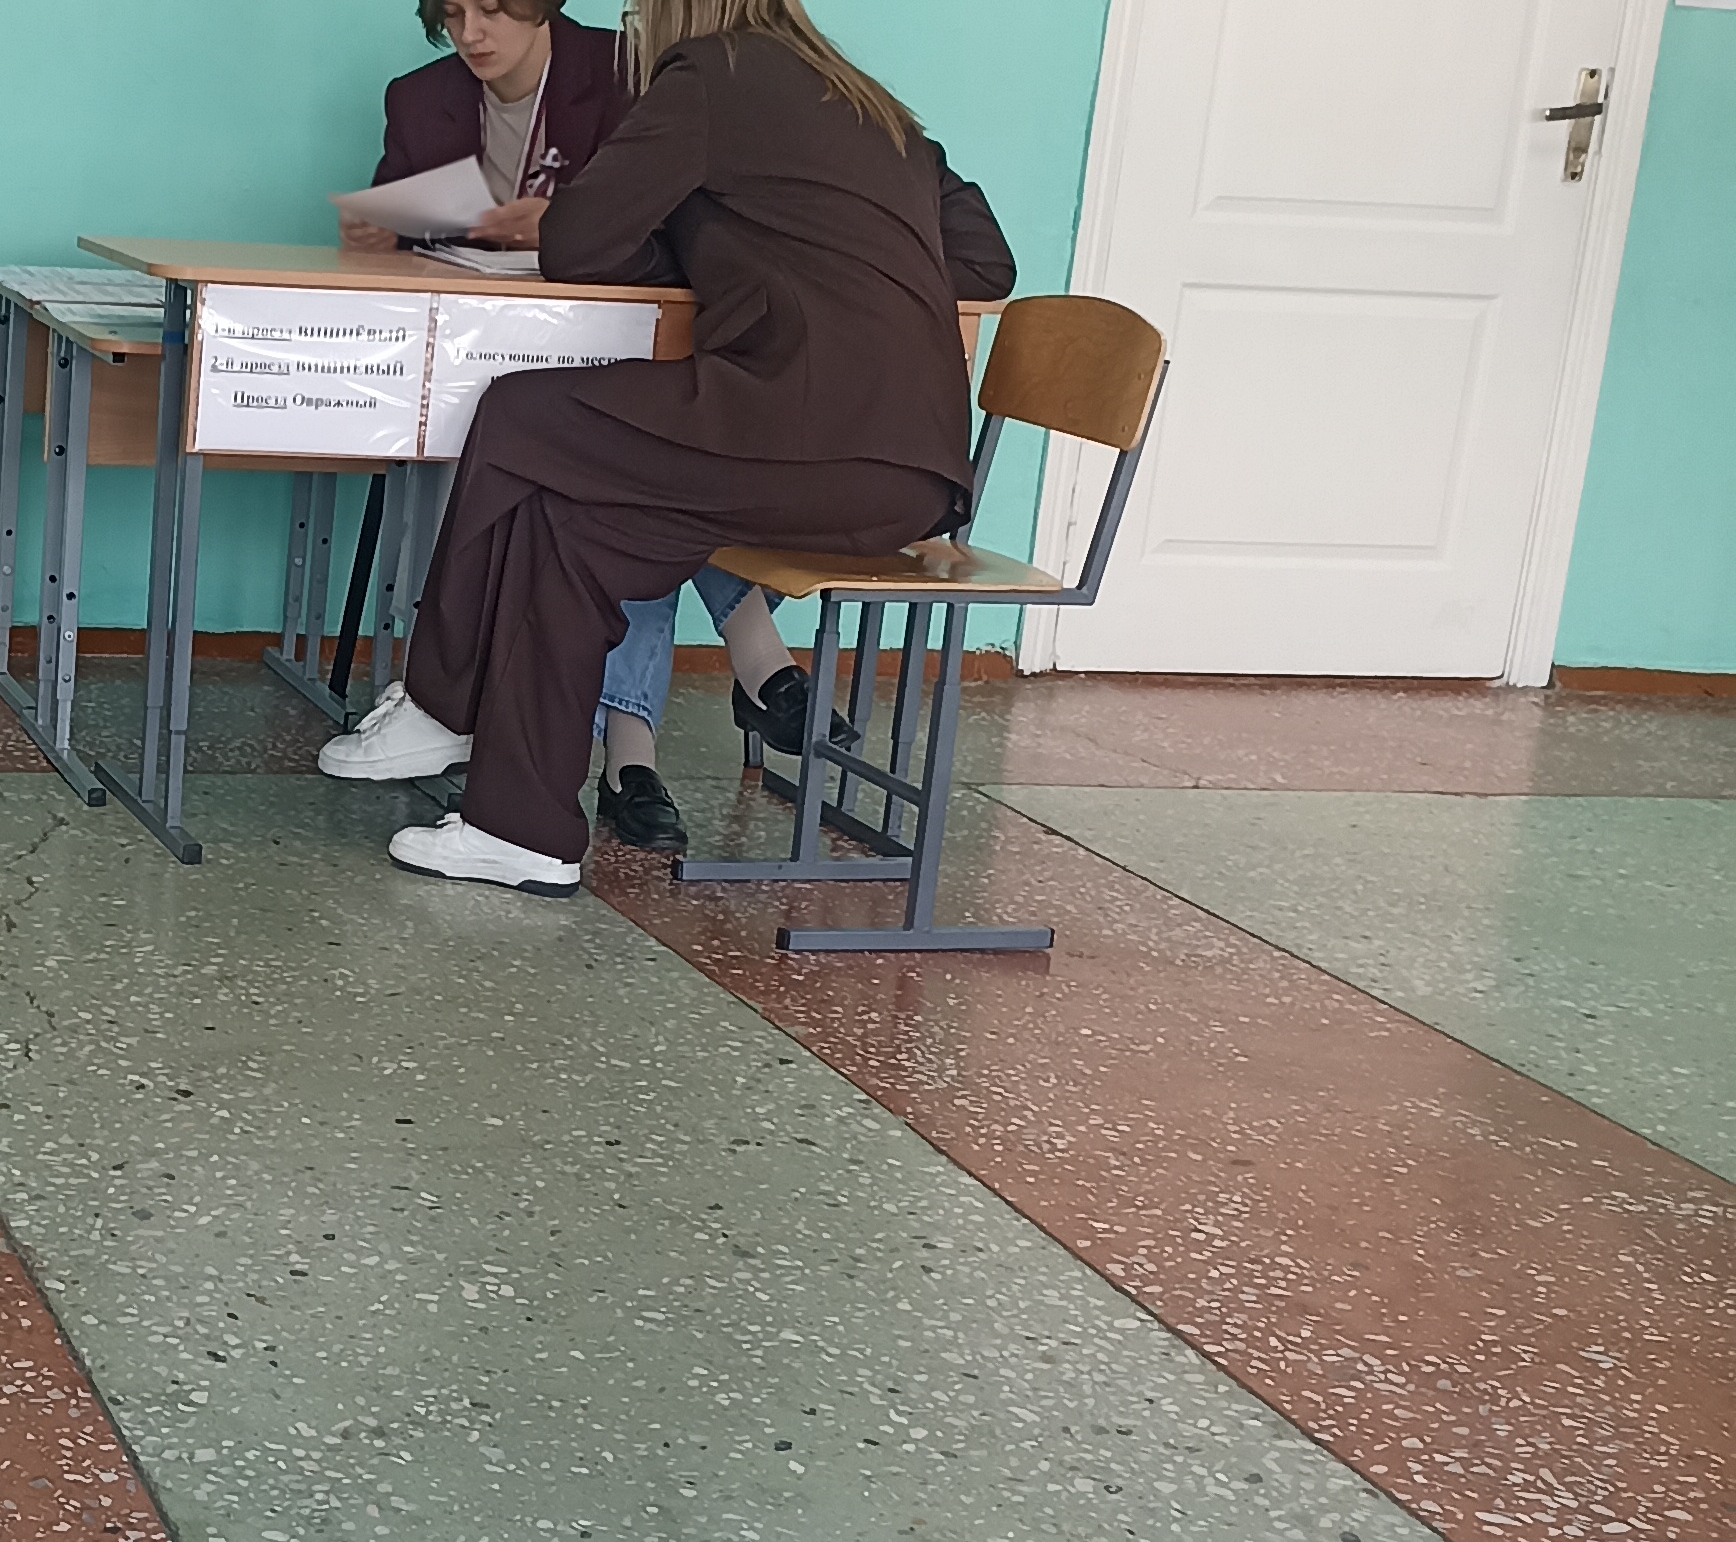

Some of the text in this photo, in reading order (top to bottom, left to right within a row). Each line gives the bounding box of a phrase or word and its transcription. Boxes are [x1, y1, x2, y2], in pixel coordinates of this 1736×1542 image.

[211, 355, 234, 371] 2-й
[239, 360, 291, 375] проезд
[557, 354, 575, 365] по
[233, 390, 377, 411] Проезд Овражный
